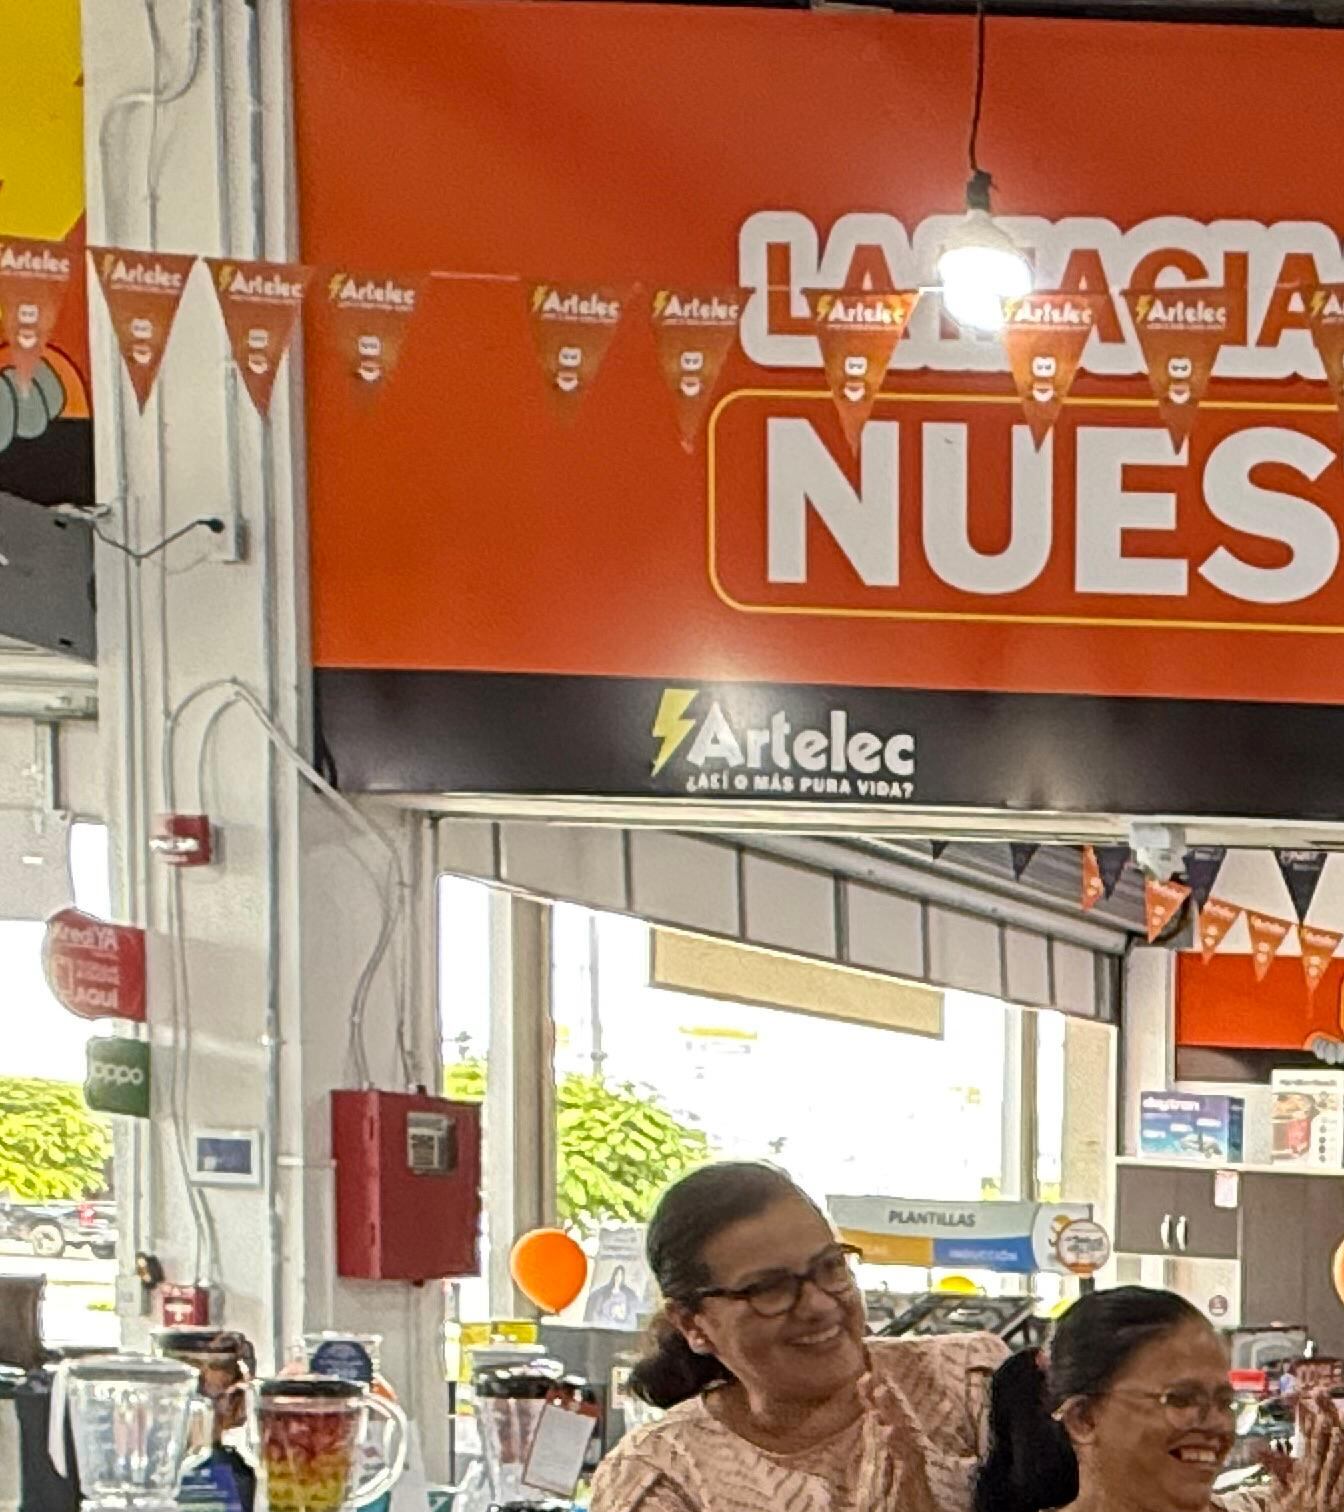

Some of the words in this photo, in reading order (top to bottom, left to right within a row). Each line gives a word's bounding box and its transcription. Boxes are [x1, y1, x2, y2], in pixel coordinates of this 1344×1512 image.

[108, 258, 184, 288] Artelec
[230, 269, 305, 299] Artelec
[340, 277, 417, 307] Artelec
[930, 237, 1330, 357] AGIA
[544, 292, 621, 323] Artelec
[665, 294, 741, 322] Artelec
[686, 701, 915, 776] Artelec
[800, 777, 852, 796] PURA
[855, 779, 915, 799] VIDA?
[888, 1209, 976, 1228] PLANTILLAS
